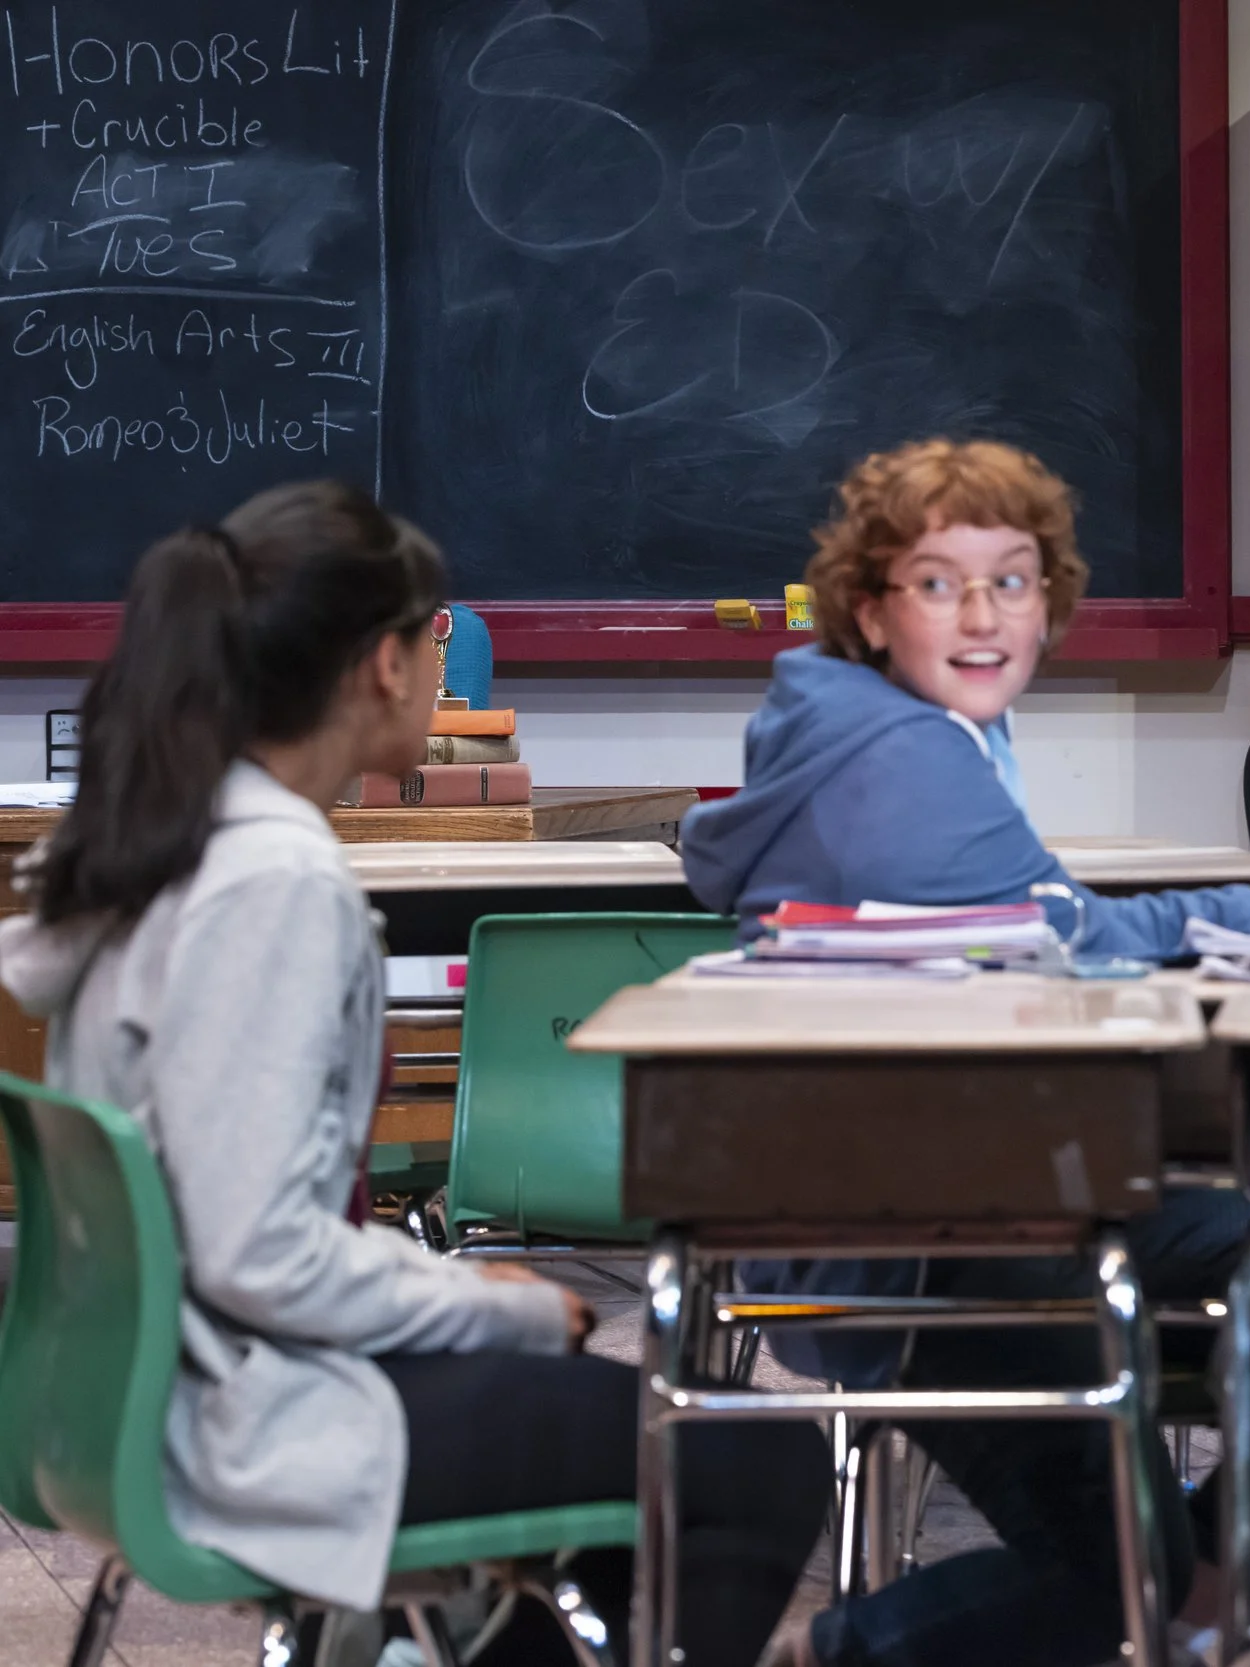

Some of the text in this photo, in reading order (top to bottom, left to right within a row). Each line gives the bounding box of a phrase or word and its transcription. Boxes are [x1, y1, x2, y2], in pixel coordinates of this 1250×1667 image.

[282, 8, 370, 79] Lit
[72, 98, 268, 148] Crucible
[465, 13, 848, 249] Sex
[13, 308, 154, 390] English
[305, 328, 372, 386] III
[581, 268, 841, 422] ED
[33, 395, 164, 461] Romeo
[206, 389, 356, 464] Juliet
[789, 619, 814, 628] Chalk
